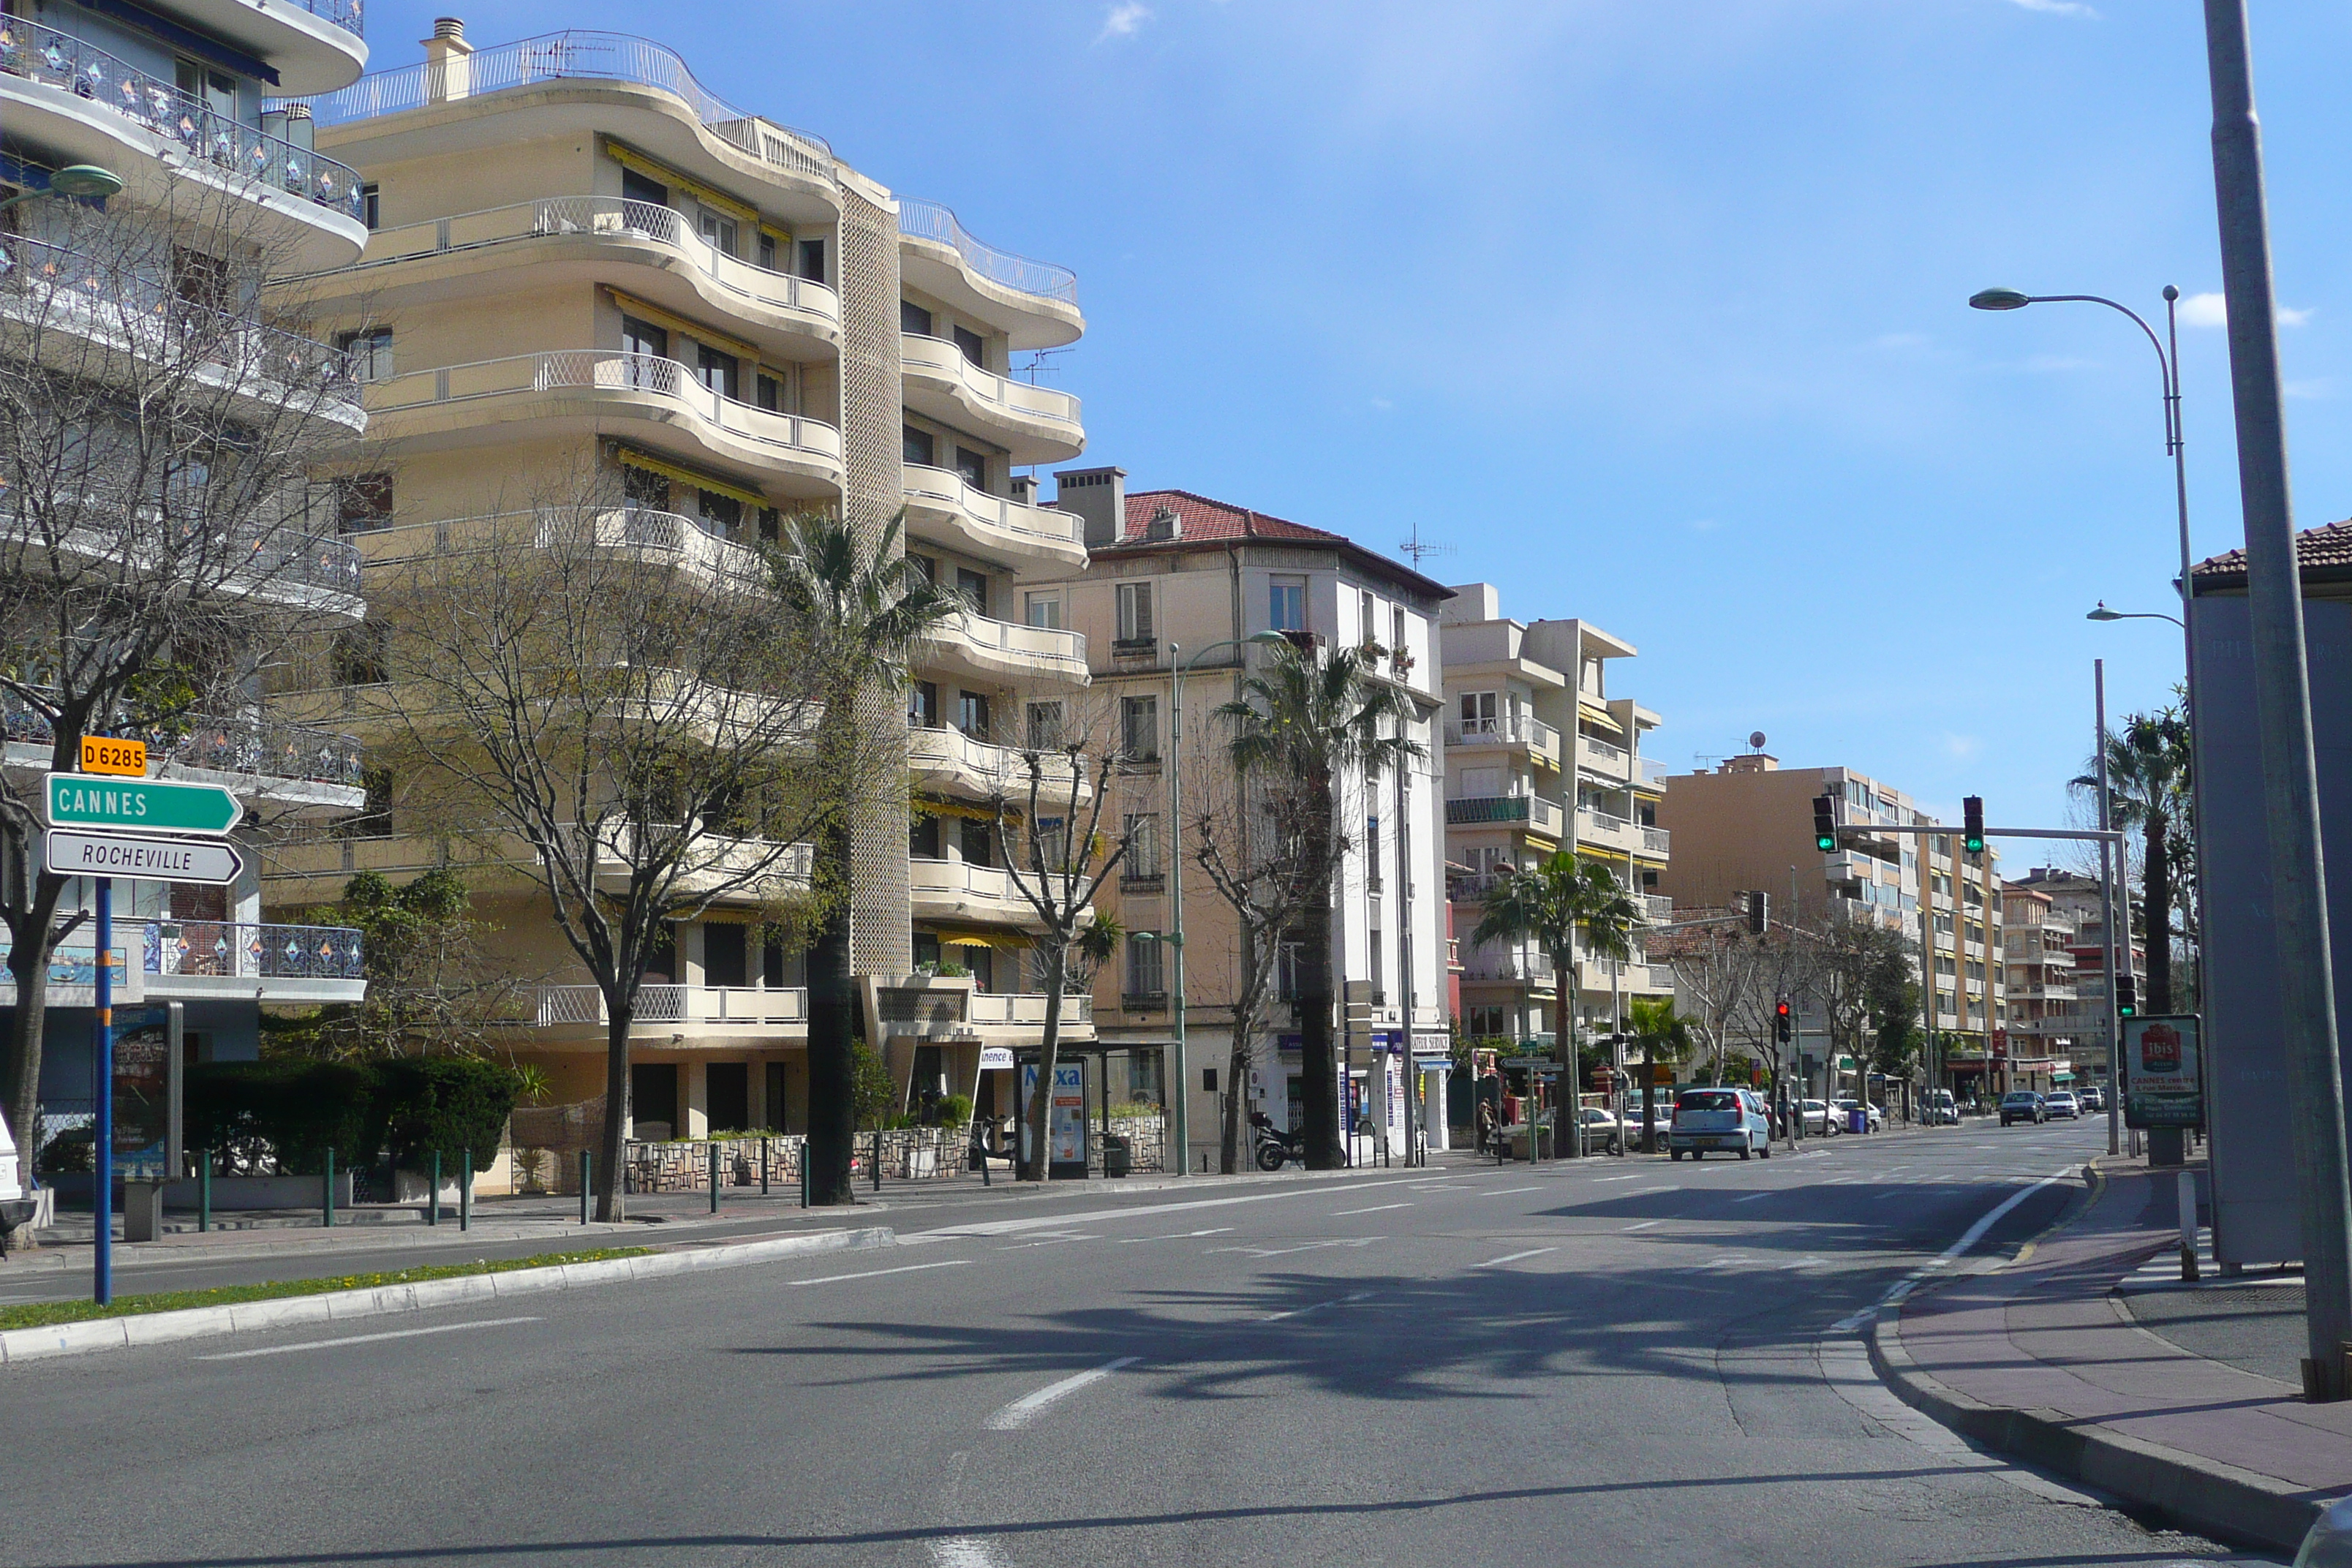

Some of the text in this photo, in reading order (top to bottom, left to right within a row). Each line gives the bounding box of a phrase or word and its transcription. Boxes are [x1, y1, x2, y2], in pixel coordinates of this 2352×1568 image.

[85, 745, 143, 769] D 6285
[59, 788, 147, 816] CANNES
[83, 844, 192, 871] ROCHEVILLE
[1411, 1036, 1428, 1049] RATEUR
[2148, 1042, 2174, 1055] ibis
[981, 1052, 1006, 1062] nence
[1025, 1065, 1081, 1086] Nxa
